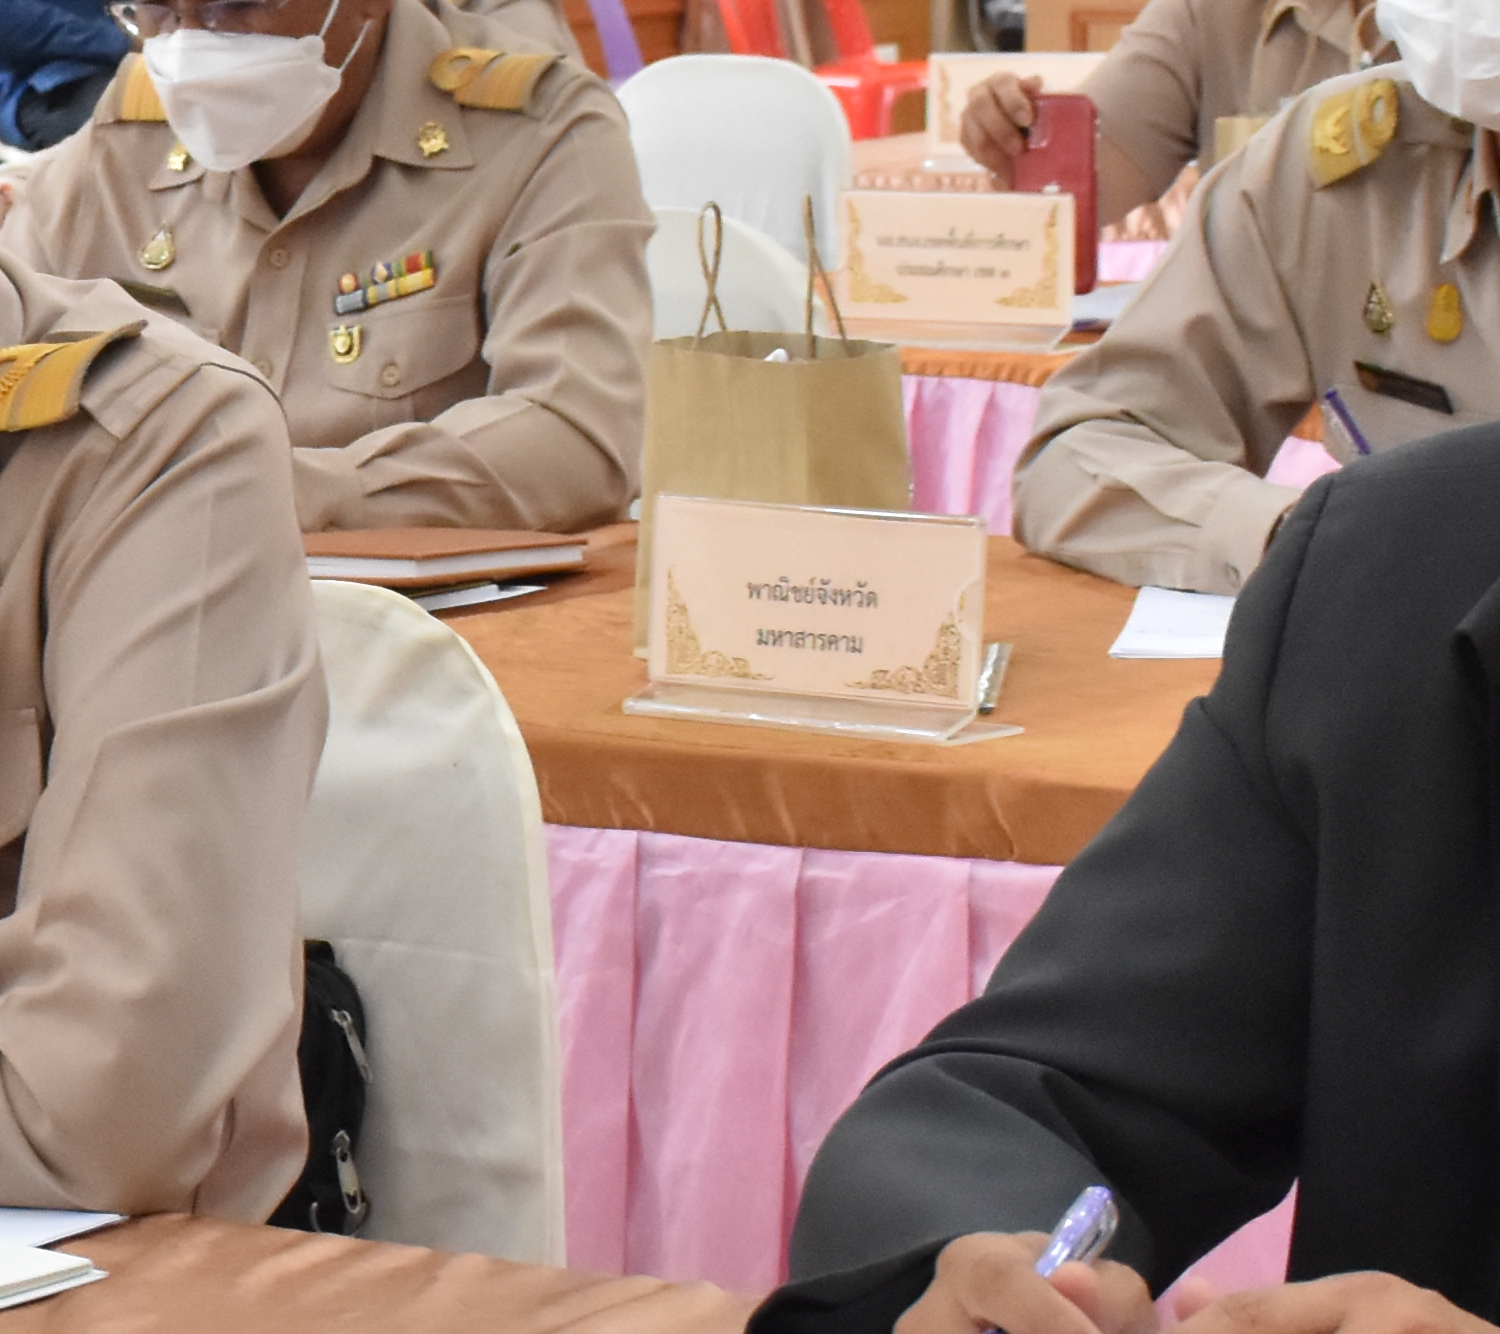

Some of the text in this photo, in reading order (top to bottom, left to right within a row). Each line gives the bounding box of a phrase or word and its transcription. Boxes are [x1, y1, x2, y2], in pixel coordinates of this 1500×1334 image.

[746, 575, 879, 609] พาณิชย์จังหวัด
[756, 627, 864, 655] มหาสารคาม
